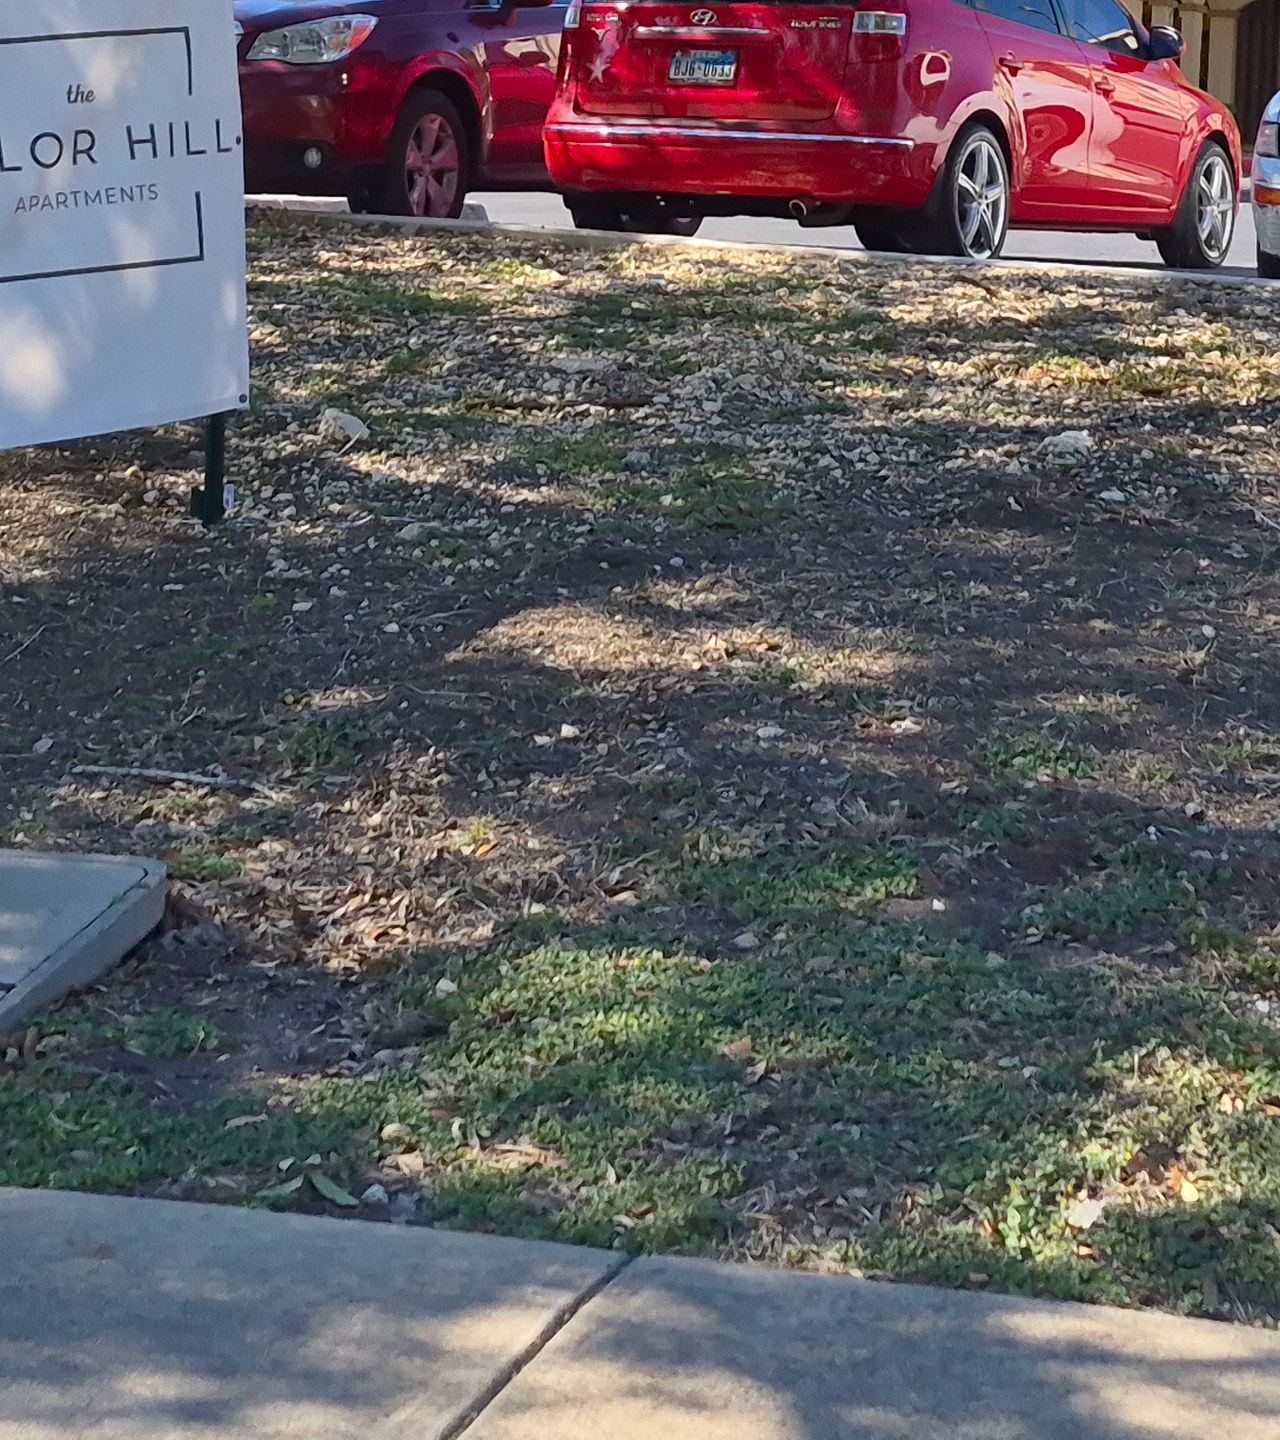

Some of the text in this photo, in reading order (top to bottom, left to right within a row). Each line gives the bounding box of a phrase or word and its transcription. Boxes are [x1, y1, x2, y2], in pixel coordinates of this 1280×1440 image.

[67, 85, 96, 105] the
[126, 119, 233, 161] HILL
[15, 184, 159, 215] APARTMENTS
